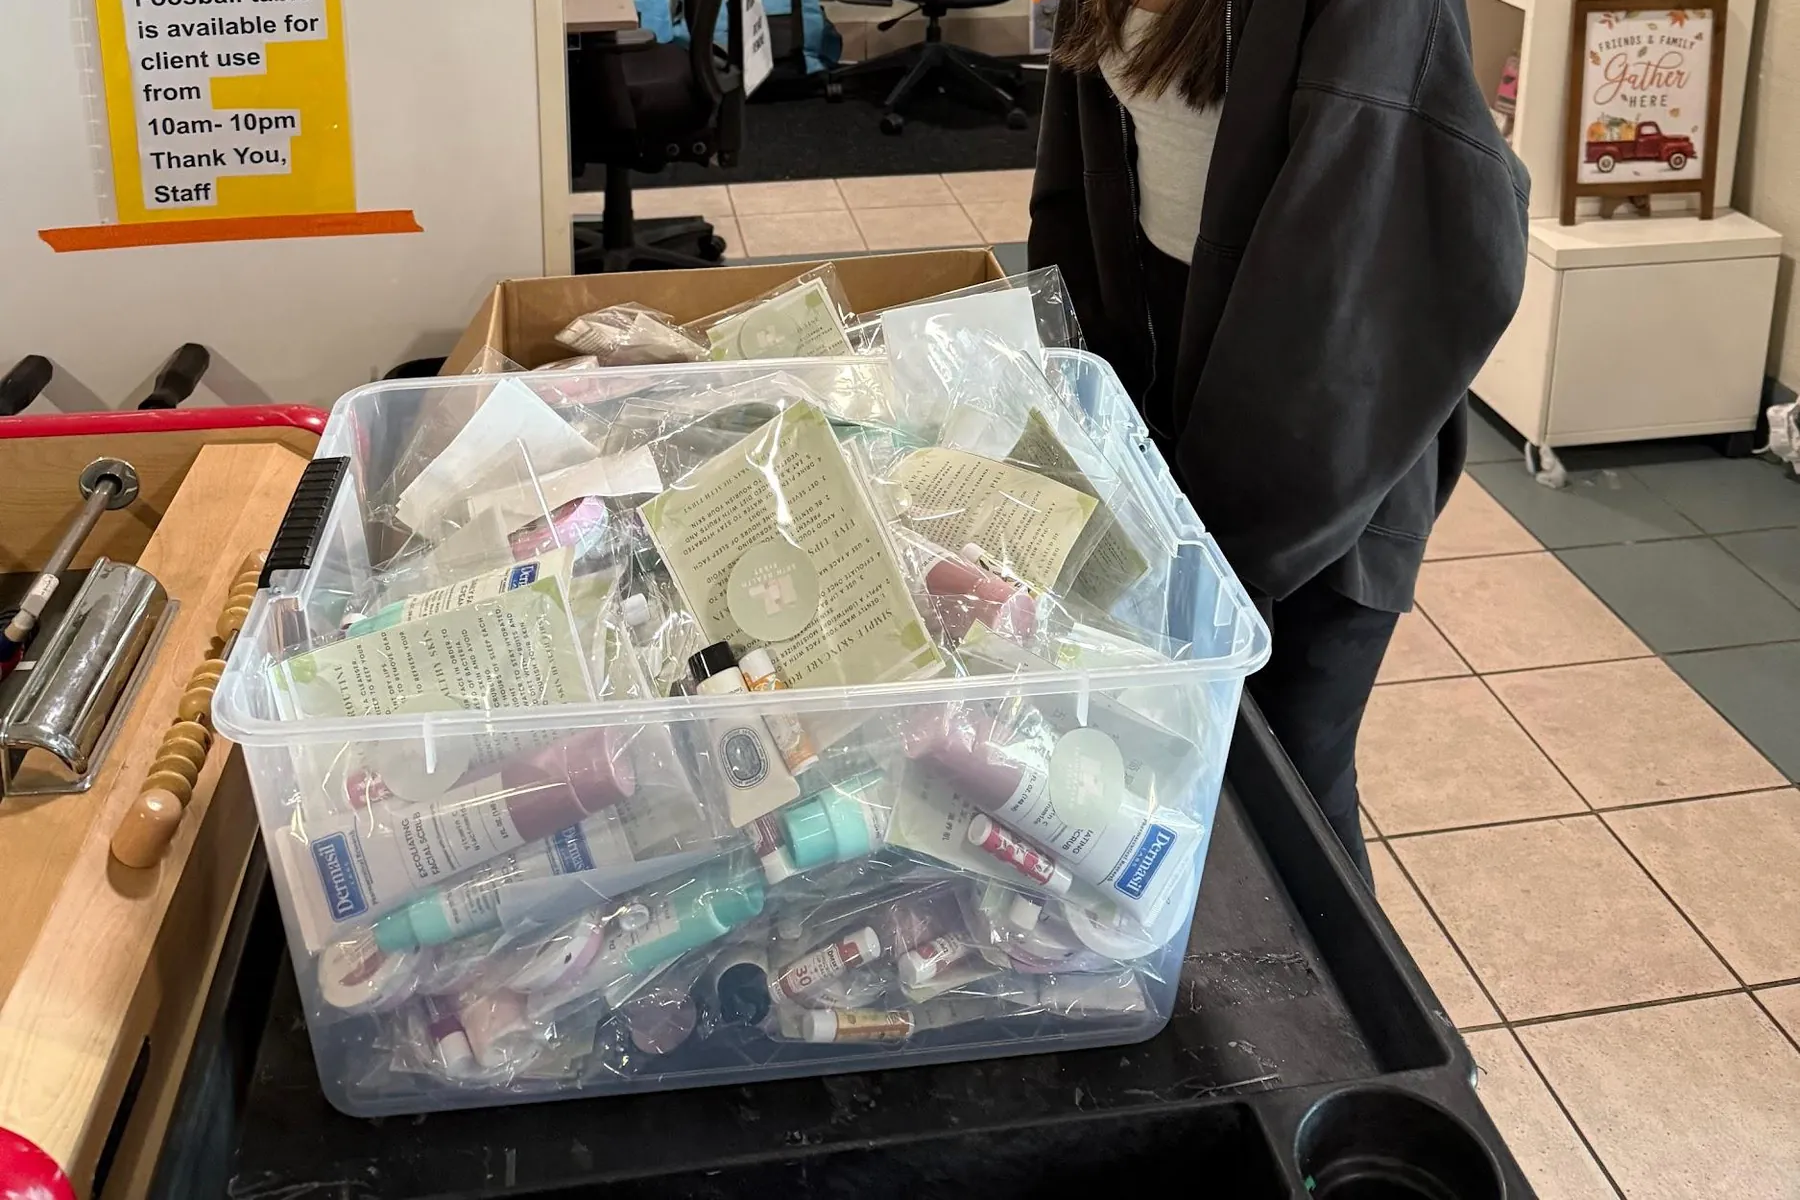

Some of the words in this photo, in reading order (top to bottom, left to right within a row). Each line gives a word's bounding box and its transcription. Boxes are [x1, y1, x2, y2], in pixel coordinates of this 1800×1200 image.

[138, 19, 159, 39] is
[167, 14, 277, 38] available
[284, 13, 319, 33] for
[1598, 35, 1642, 52] FRIENDS
[1647, 35, 1654, 44] &
[1659, 35, 1696, 50] FAMILY
[140, 50, 209, 72] client
[217, 49, 261, 68] use
[1593, 51, 1692, 106] Gather
[143, 82, 201, 102] from
[1628, 94, 1669, 108] HERE
[147, 113, 223, 136] 10am-
[230, 111, 296, 135] 10pm
[150, 148, 227, 170] Thank
[233, 146, 288, 168] You,
[154, 182, 212, 203] Staff
[792, 458, 804, 470] EAT
[797, 461, 815, 477] DRINK
[752, 478, 761, 486] TO
[807, 480, 819, 491] GET
[725, 484, 752, 505] NOURISH
[739, 494, 753, 506] DIET
[787, 489, 806, 505] SEVEN
[706, 504, 724, 518] YOUR
[721, 505, 738, 518] WITH
[743, 498, 763, 515] WATER
[814, 499, 823, 508] BE
[699, 516, 721, 534] FRUITS
[716, 519, 732, 533] STAY
[732, 513, 742, 522] TO
[796, 512, 821, 533] PREVENT
[816, 513, 835, 529] AVOID
[740, 521, 761, 538] HOURS
[834, 518, 855, 538] FIVE
[684, 531, 698, 543] AND
[731, 536, 739, 545] OF
[712, 543, 730, 558] SLEEP
[807, 537, 829, 555] TIPS
[851, 542, 863, 553] USE
[693, 556, 711, 571] EACH
[828, 555, 845, 568] FACE
[844, 556, 874, 580] EXFOLIATE
[706, 567, 726, 584] AVOID
[826, 578, 843, 593] ONCE
[845, 579, 857, 590] USE
[866, 583, 882, 598] APPLY
[708, 596, 718, 604] TO
[858, 597, 880, 615] GENTLY
[506, 612, 515, 628] AND
[712, 606, 730, 621] KIN
[839, 613, 856, 628] WASH
[478, 617, 488, 637] EACH
[858, 610, 892, 637] SIMPLE
[380, 632, 391, 651] DEAD
[399, 631, 409, 650] YOUR
[440, 628, 448, 638] TO
[461, 628, 473, 652] AVOID
[821, 627, 838, 641] YOUR
[423, 630, 437, 657] SKIN
[484, 639, 495, 660] SLEEP
[780, 629, 818, 658] MOISTURIZER
[805, 638, 821, 651] FACE
[356, 644, 366, 663] YOUR
[445, 641, 457, 664] ORDER
[508, 649, 518, 667] STAY
[788, 650, 804, 663] WITH
[806, 636, 854, 672] SKINCARE
[387, 653, 400, 681] REMOVE
[406, 652, 420, 682] REFRESH
[469, 654, 479, 670] AND
[492, 663, 499, 672] OF
[363, 666, 372, 682] KEEP
[475, 672, 485, 689] SKIN
[514, 669, 521, 679] TO
[532, 664, 544, 694] OURISH
[334, 666, 356, 717] ROUTINE
[368, 684, 376, 695] TO
[386, 680, 395, 694] DRY
[396, 683, 404, 693] TO
[416, 683, 423, 693] TO
[456, 677, 466, 696] FACE
[467, 679, 475, 689] OF
[496, 674, 507, 700] HOURS
[526, 680, 536, 697] DIET
[413, 811, 428, 844] SCRUB
[401, 819, 428, 878] EXFOLIATING
[423, 844, 440, 875] FACIAL
[1125, 830, 1171, 893] Dermasil
[315, 842, 357, 914] Dermasil
[793, 964, 813, 987] 30
